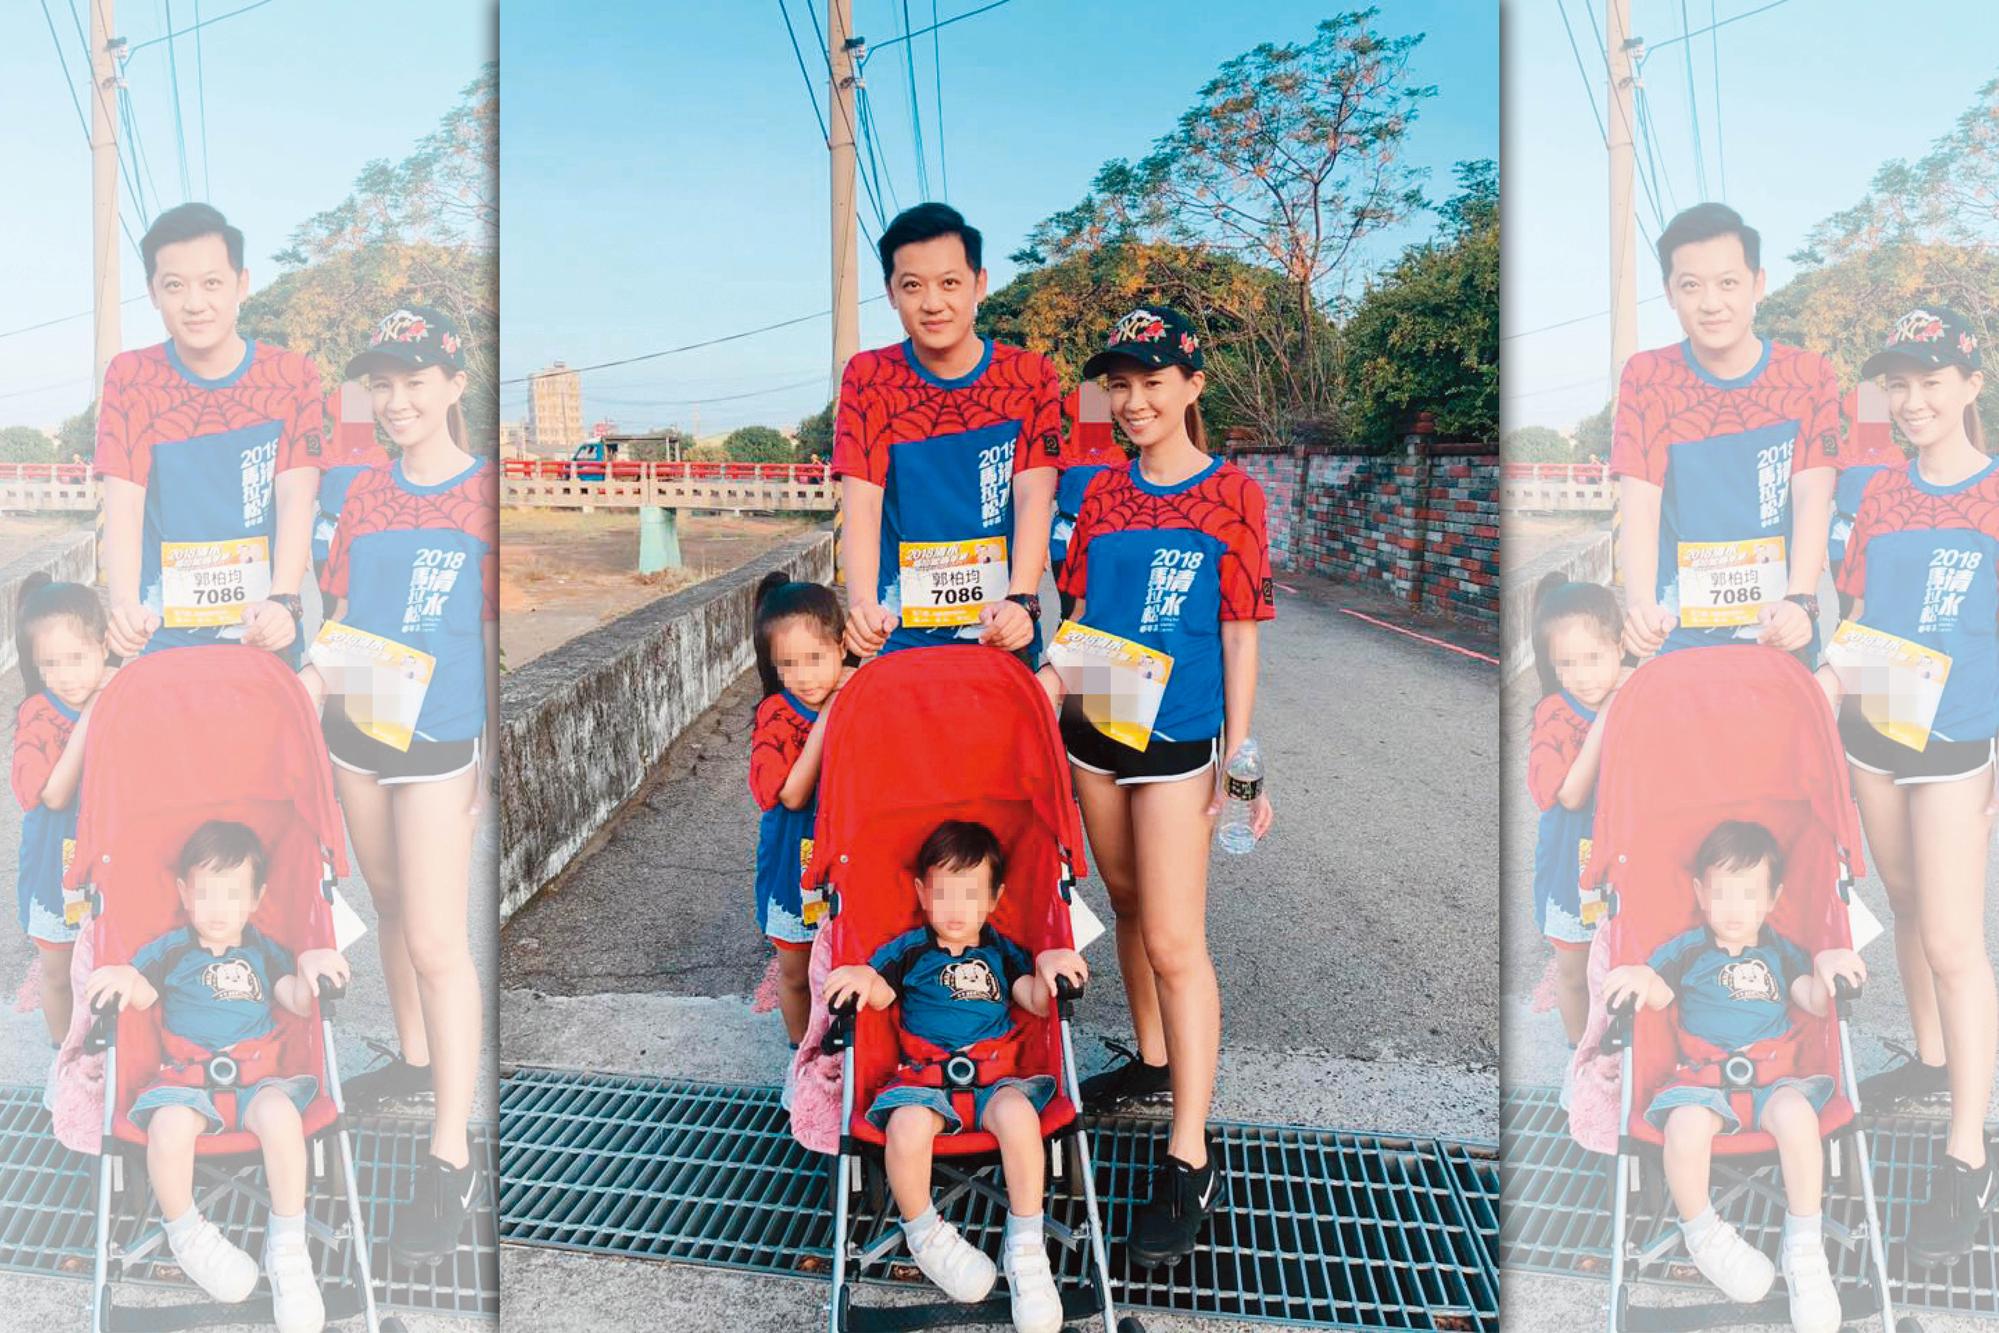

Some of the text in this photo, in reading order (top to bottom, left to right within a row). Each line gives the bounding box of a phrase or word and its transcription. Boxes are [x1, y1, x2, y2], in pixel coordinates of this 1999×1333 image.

[412, 548, 467, 570] 2018
[1150, 548, 1205, 570] 2018
[1928, 548, 1983, 570] 2018
[932, 570, 980, 586] 郭柏均
[193, 587, 246, 605] 7086
[931, 587, 984, 605] 7086
[1159, 568, 1197, 616] 清水
[1709, 587, 1762, 605] 7086
